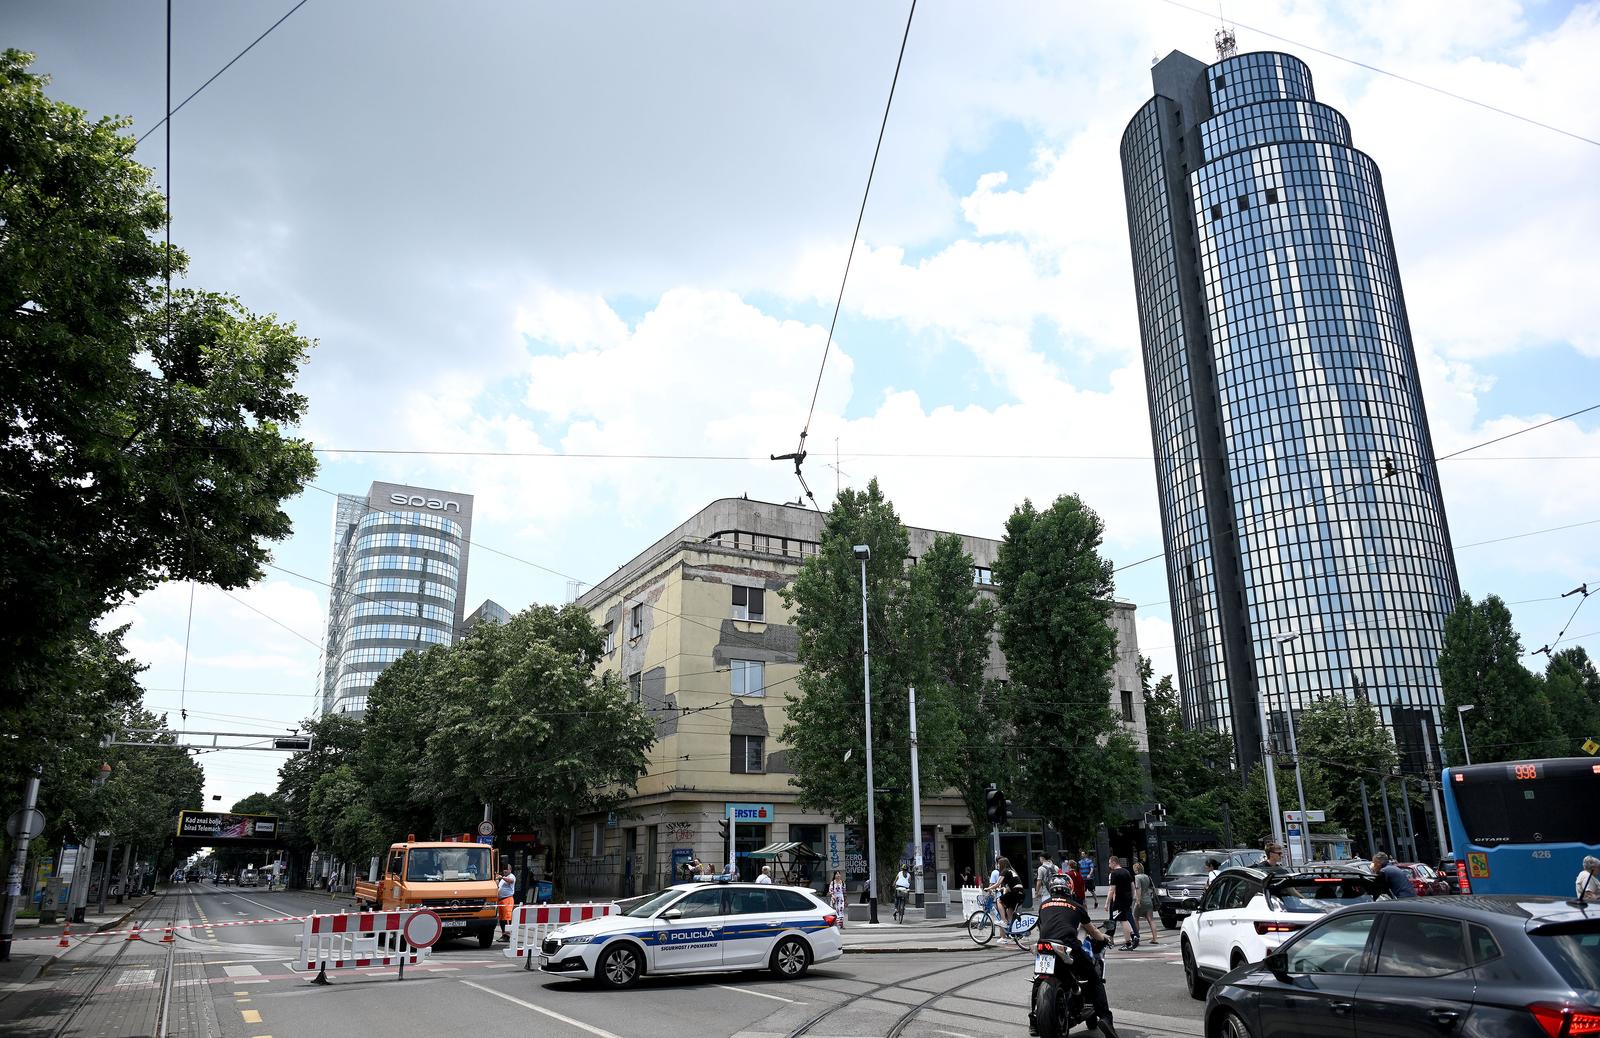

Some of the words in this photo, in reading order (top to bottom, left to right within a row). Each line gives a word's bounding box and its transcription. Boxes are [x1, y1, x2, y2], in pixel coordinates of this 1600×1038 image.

[390, 493, 460, 513] span
[1515, 764, 1537, 779] 998
[197, 824, 221, 832] Telemach
[1532, 850, 1551, 859] 426
[845, 866, 868, 874] GIVEN.
[1015, 917, 1035, 929] Bajs
[671, 931, 715, 940] POLICIJA
